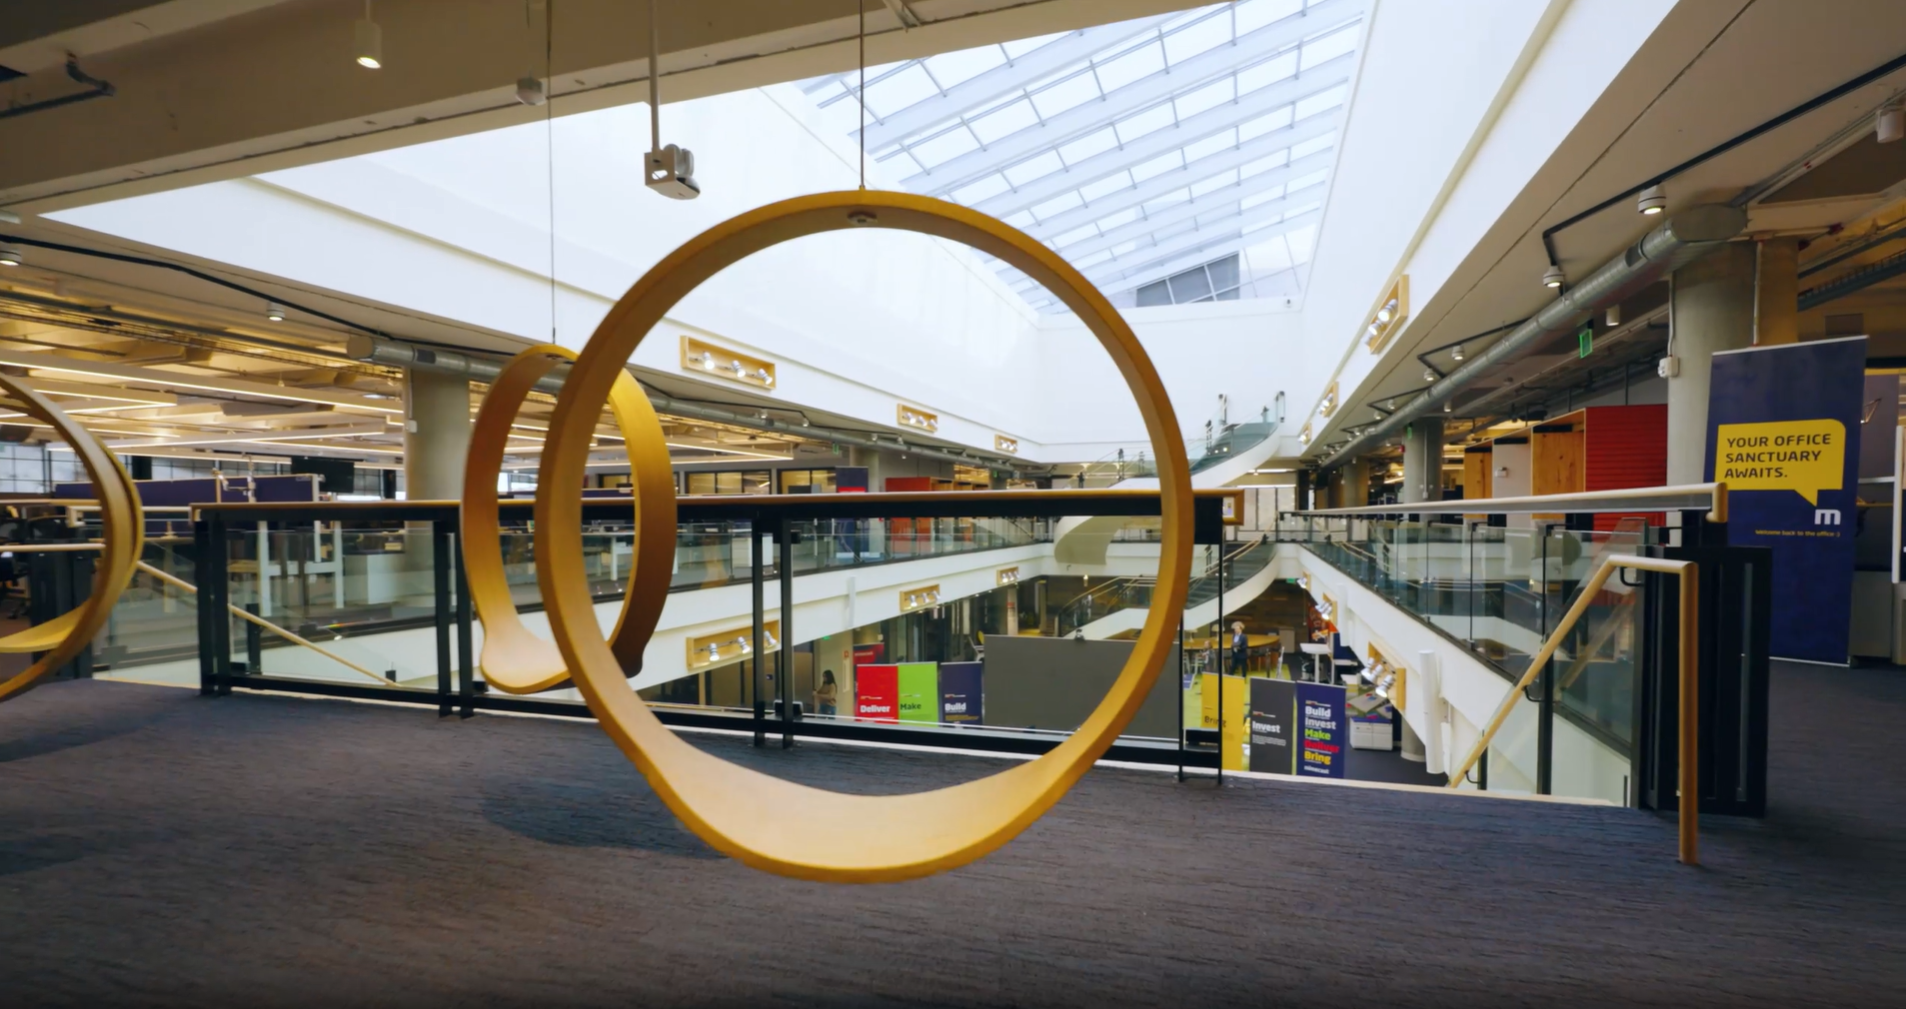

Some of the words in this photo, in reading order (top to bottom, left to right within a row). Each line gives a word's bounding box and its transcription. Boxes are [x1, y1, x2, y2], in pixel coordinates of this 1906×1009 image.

[1727, 436, 1769, 448] YOUR
[1774, 433, 1831, 447] OFFICE
[1725, 450, 1822, 464] SANCTUARY
[1724, 467, 1788, 479] AWAITS.
[1814, 509, 1841, 525] m
[860, 705, 891, 713] Deliver
[900, 703, 921, 711] Make
[945, 702, 967, 711] Build
[1305, 706, 1331, 718] Build
[1252, 721, 1280, 733] Invest
[1305, 717, 1336, 730] Invest
[1305, 728, 1331, 740] Make
[1304, 751, 1331, 765] Bring
